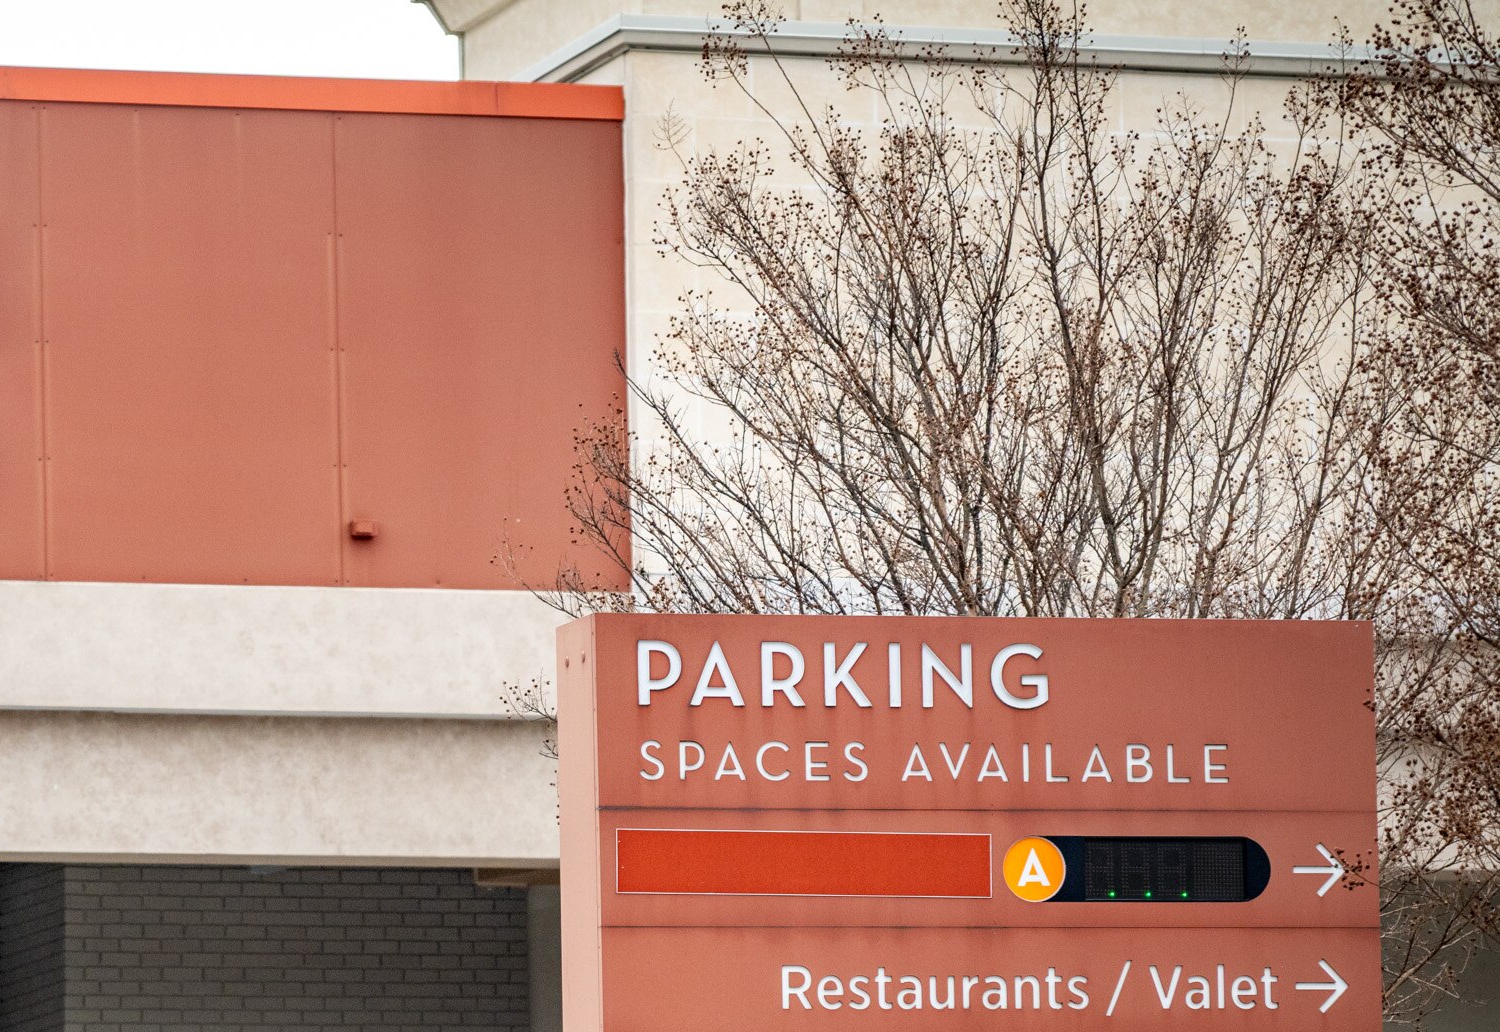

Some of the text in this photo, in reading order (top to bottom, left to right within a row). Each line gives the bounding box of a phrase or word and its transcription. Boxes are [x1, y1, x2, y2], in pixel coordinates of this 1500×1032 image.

[637, 639, 1049, 710] PARKING
[639, 740, 1231, 784] SPACES AVAILABLE
[1017, 847, 1051, 887] A
[780, 965, 1089, 1010] Restaurants
[1150, 967, 1278, 1011] Valet
